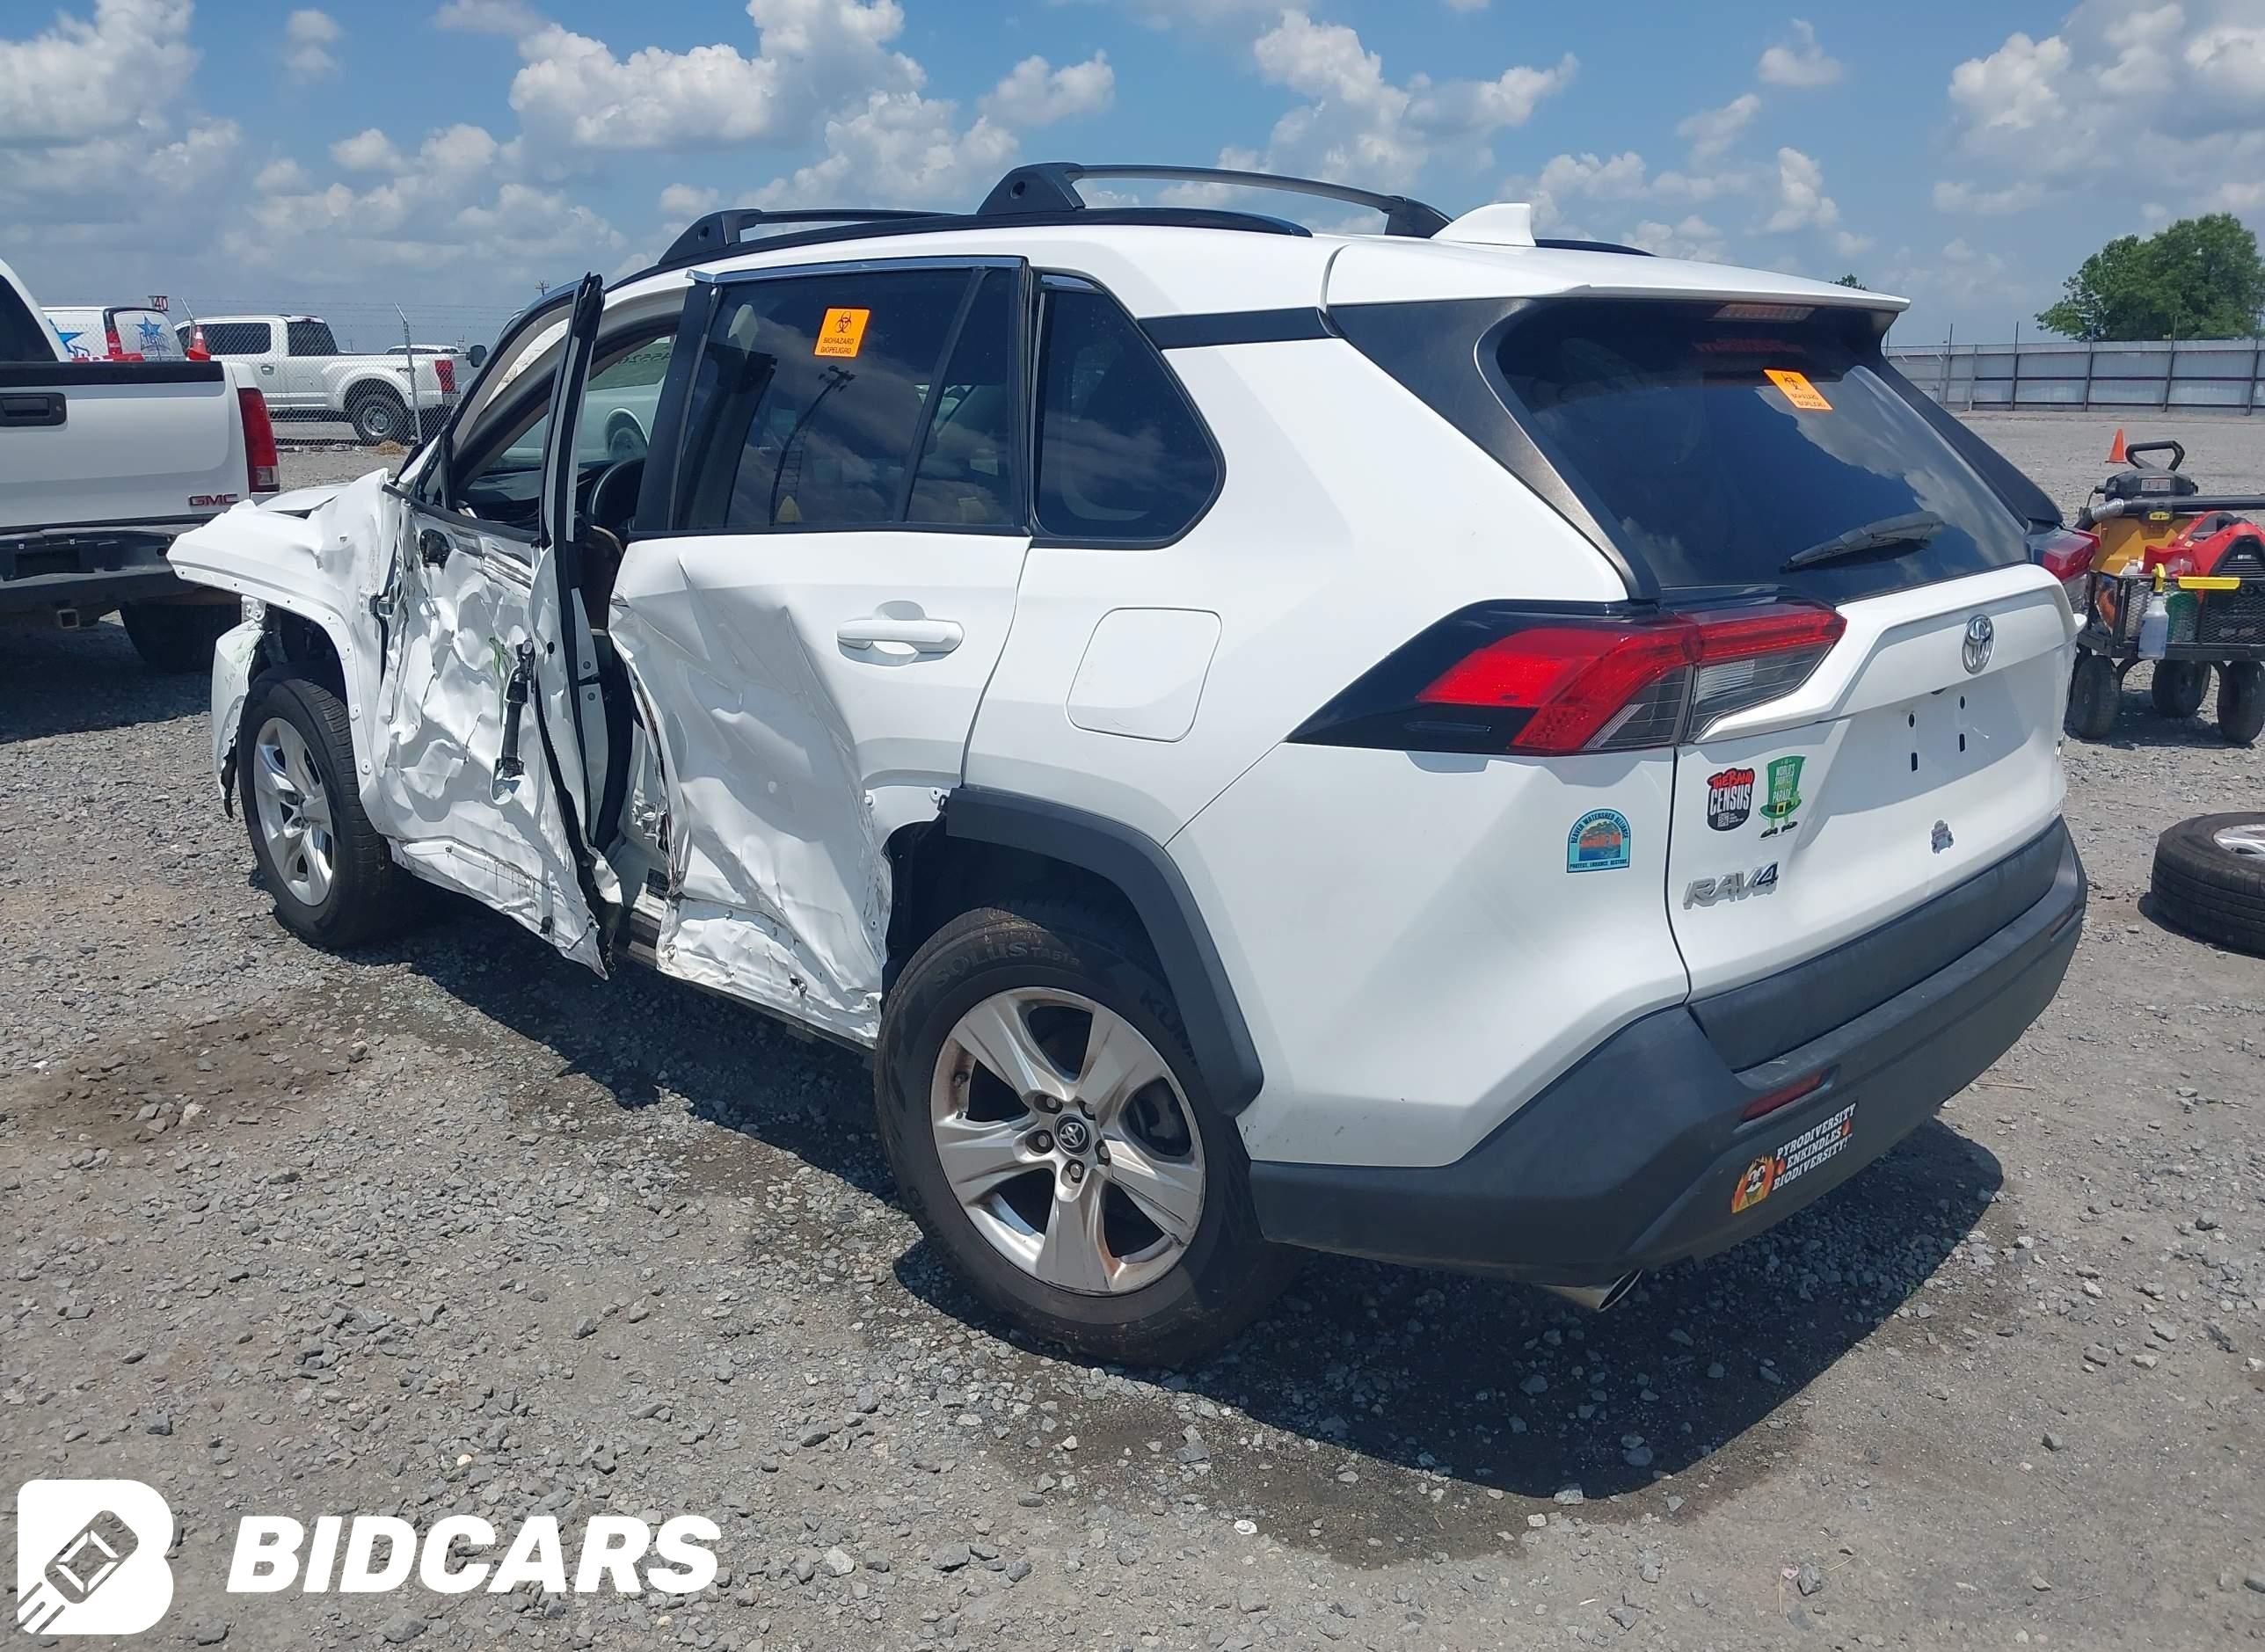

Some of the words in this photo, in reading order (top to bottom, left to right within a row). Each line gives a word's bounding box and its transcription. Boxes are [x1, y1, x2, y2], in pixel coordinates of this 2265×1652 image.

[823, 337, 855, 346] BIOHAZARD
[189, 493, 240, 507] GMC
[1709, 776, 1730, 790] THE
[1729, 770, 1753, 787] BAND
[1710, 784, 1752, 816] CENSUS
[1570, 823, 1584, 844] BEAVER
[1583, 812, 1615, 825] WATERSHED
[1613, 816, 1628, 839] ALLIANCE
[1683, 861, 1780, 911] RAV4
[935, 942, 1028, 988] SOLUS
[1776, 1103, 1856, 1161] PYRODIVERSITY
[1786, 1125, 1842, 1169] ENKINDLES
